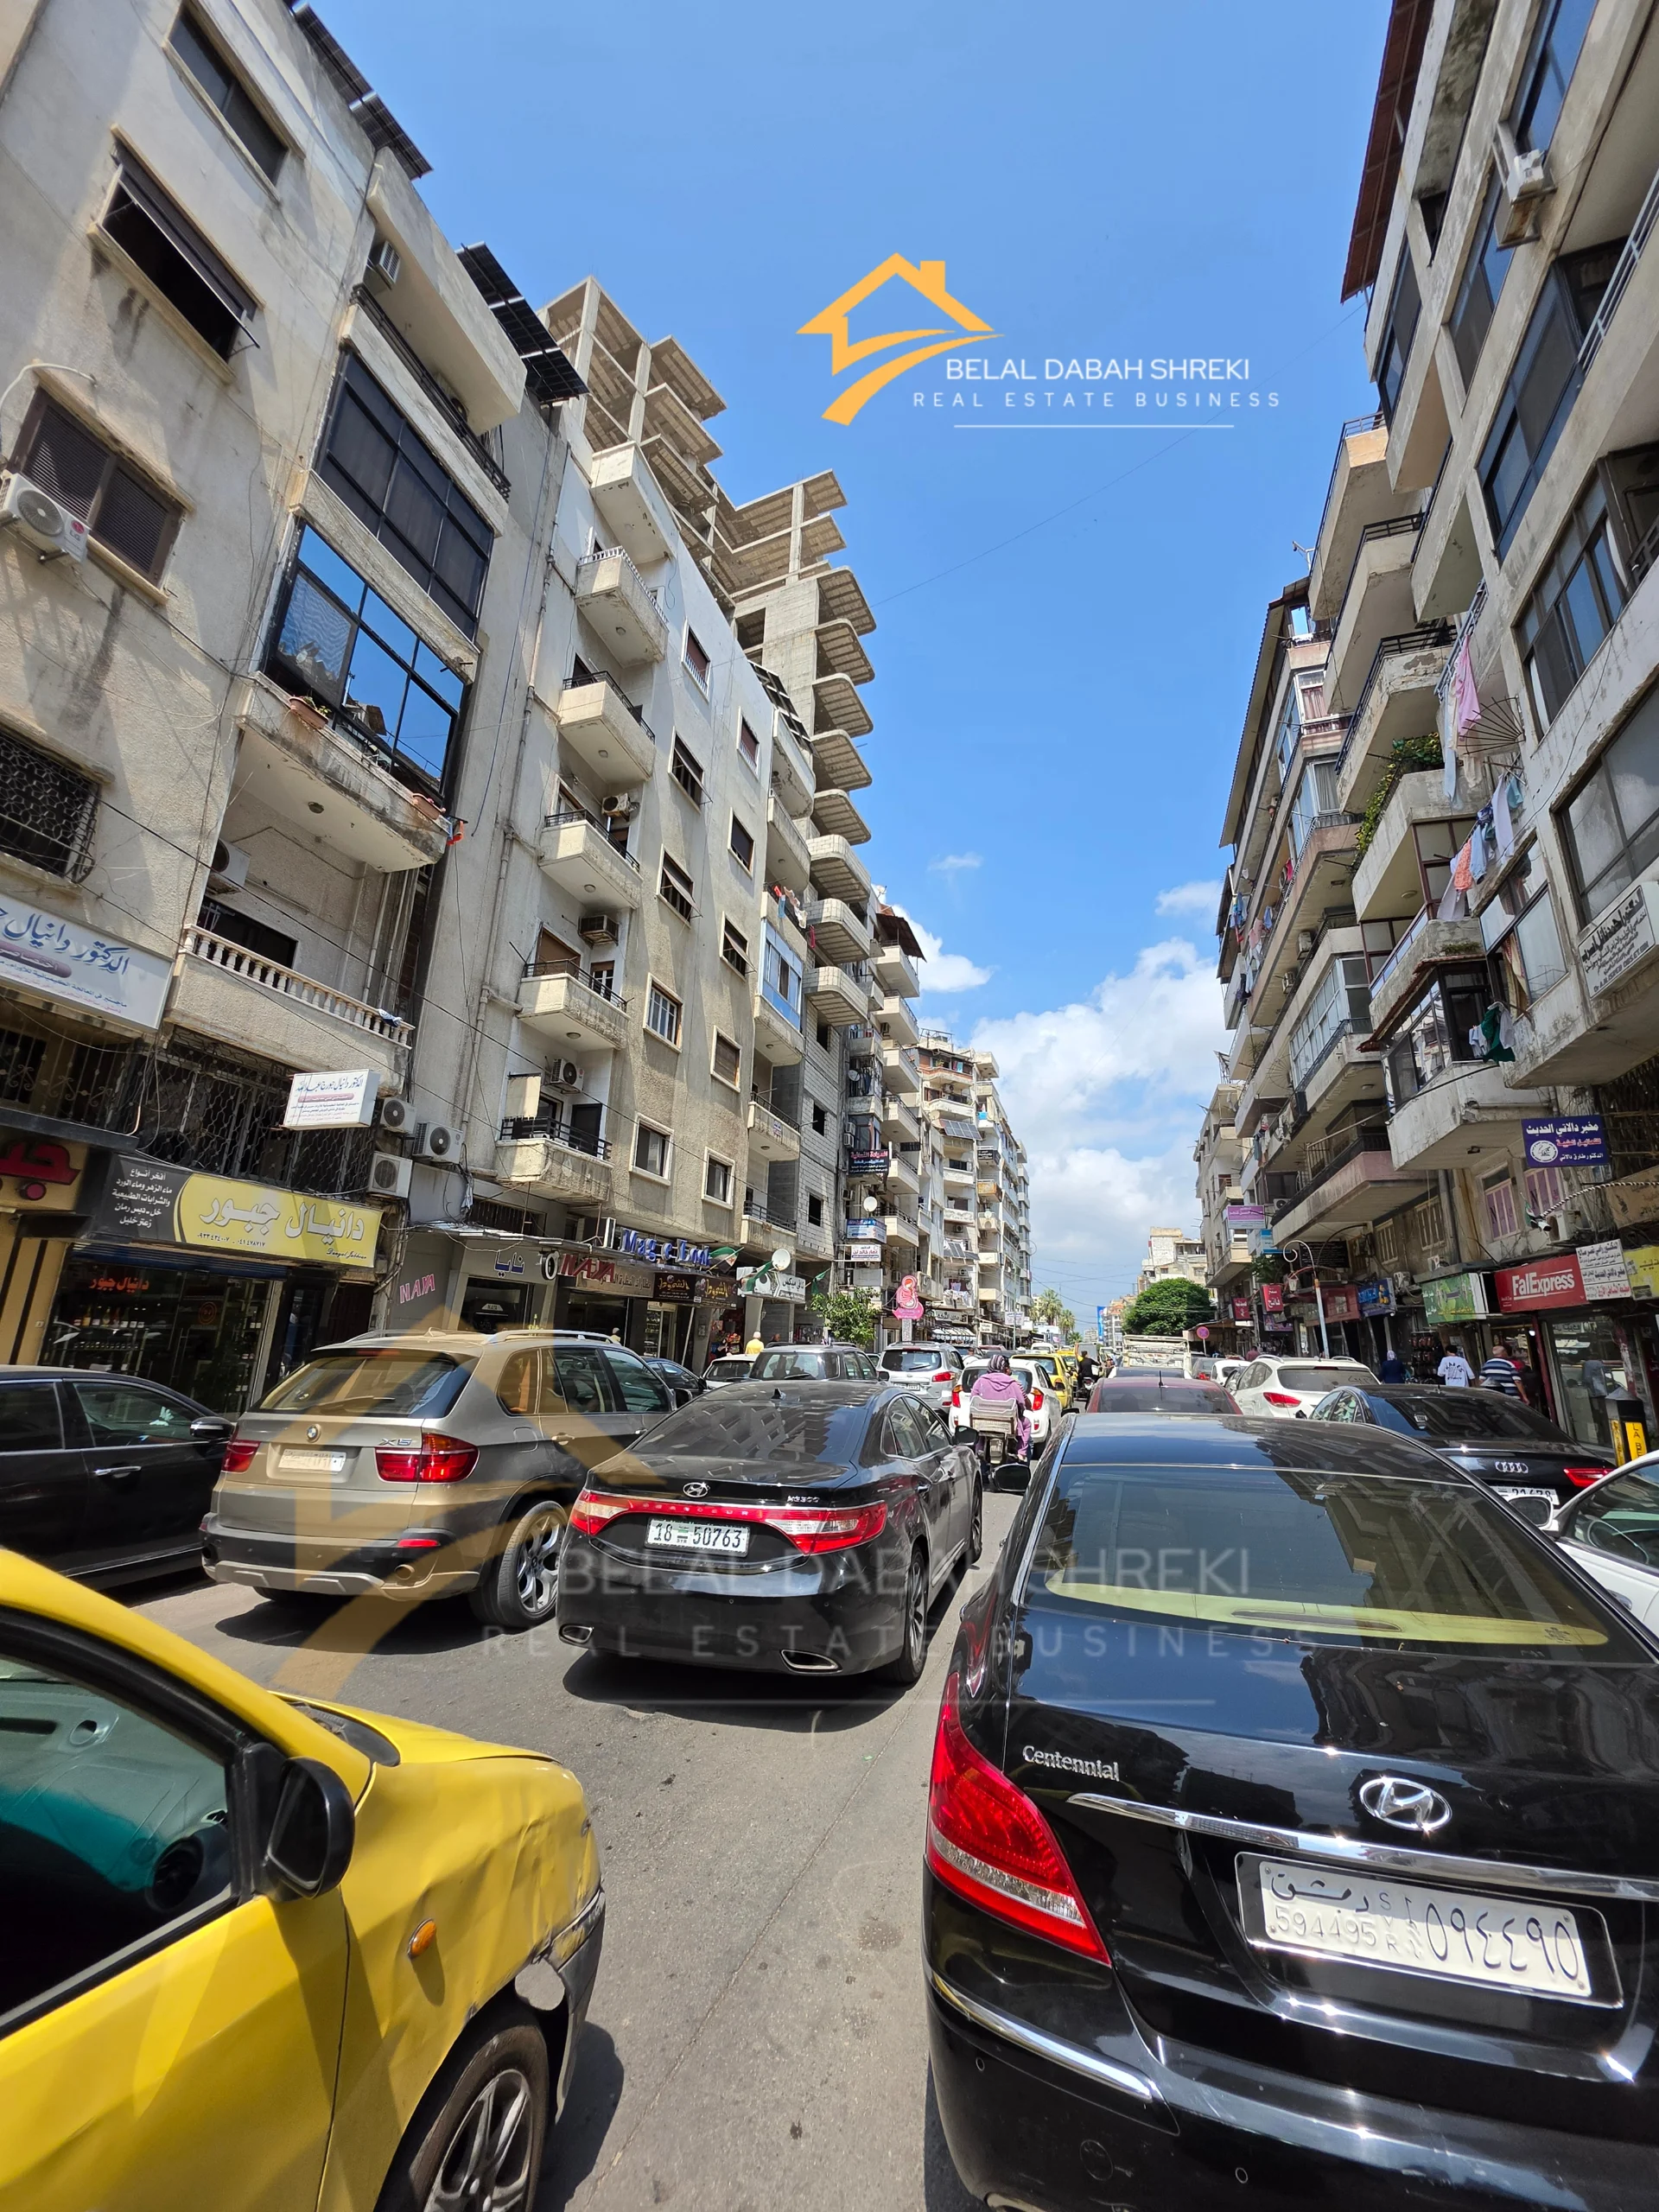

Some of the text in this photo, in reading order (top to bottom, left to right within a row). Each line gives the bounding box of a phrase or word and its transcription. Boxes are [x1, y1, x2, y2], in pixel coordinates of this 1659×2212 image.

[3, 912, 130, 975] الدكتور دانيال
[1526, 1121, 1599, 1137] مخبر دالاتي الحديث
[1559, 1152, 1604, 1162] الدكتور طارق دالاتي
[116, 1179, 131, 1188] الورد
[150, 1172, 166, 1181] أفخر
[131, 1181, 145, 1191] وماء
[145, 1184, 162, 1194] الزهر
[111, 1188, 141, 1201] الطبيعية
[114, 1203, 130, 1213] رمان
[149, 1208, 162, 1217] خل
[119, 1216, 137, 1224] خليل
[200, 1198, 365, 1245] دانيال جبور
[493, 1249, 525, 1278] نايا
[557, 1253, 616, 1283] NAYA
[89, 1276, 149, 1293] دانيال جبور
[399, 1274, 435, 1304] NAYA
[1512, 1272, 1575, 1296] FalExpress
[379, 1437, 412, 1446] X5
[653, 1522, 742, 1548] 18 50763
[1022, 1745, 1120, 1782] Centennial
[1270, 1872, 1370, 1913] دمشق
[1426, 1902, 1580, 1981] ٥٩٤٤٩٥
[1274, 1906, 1377, 1948] 594495
